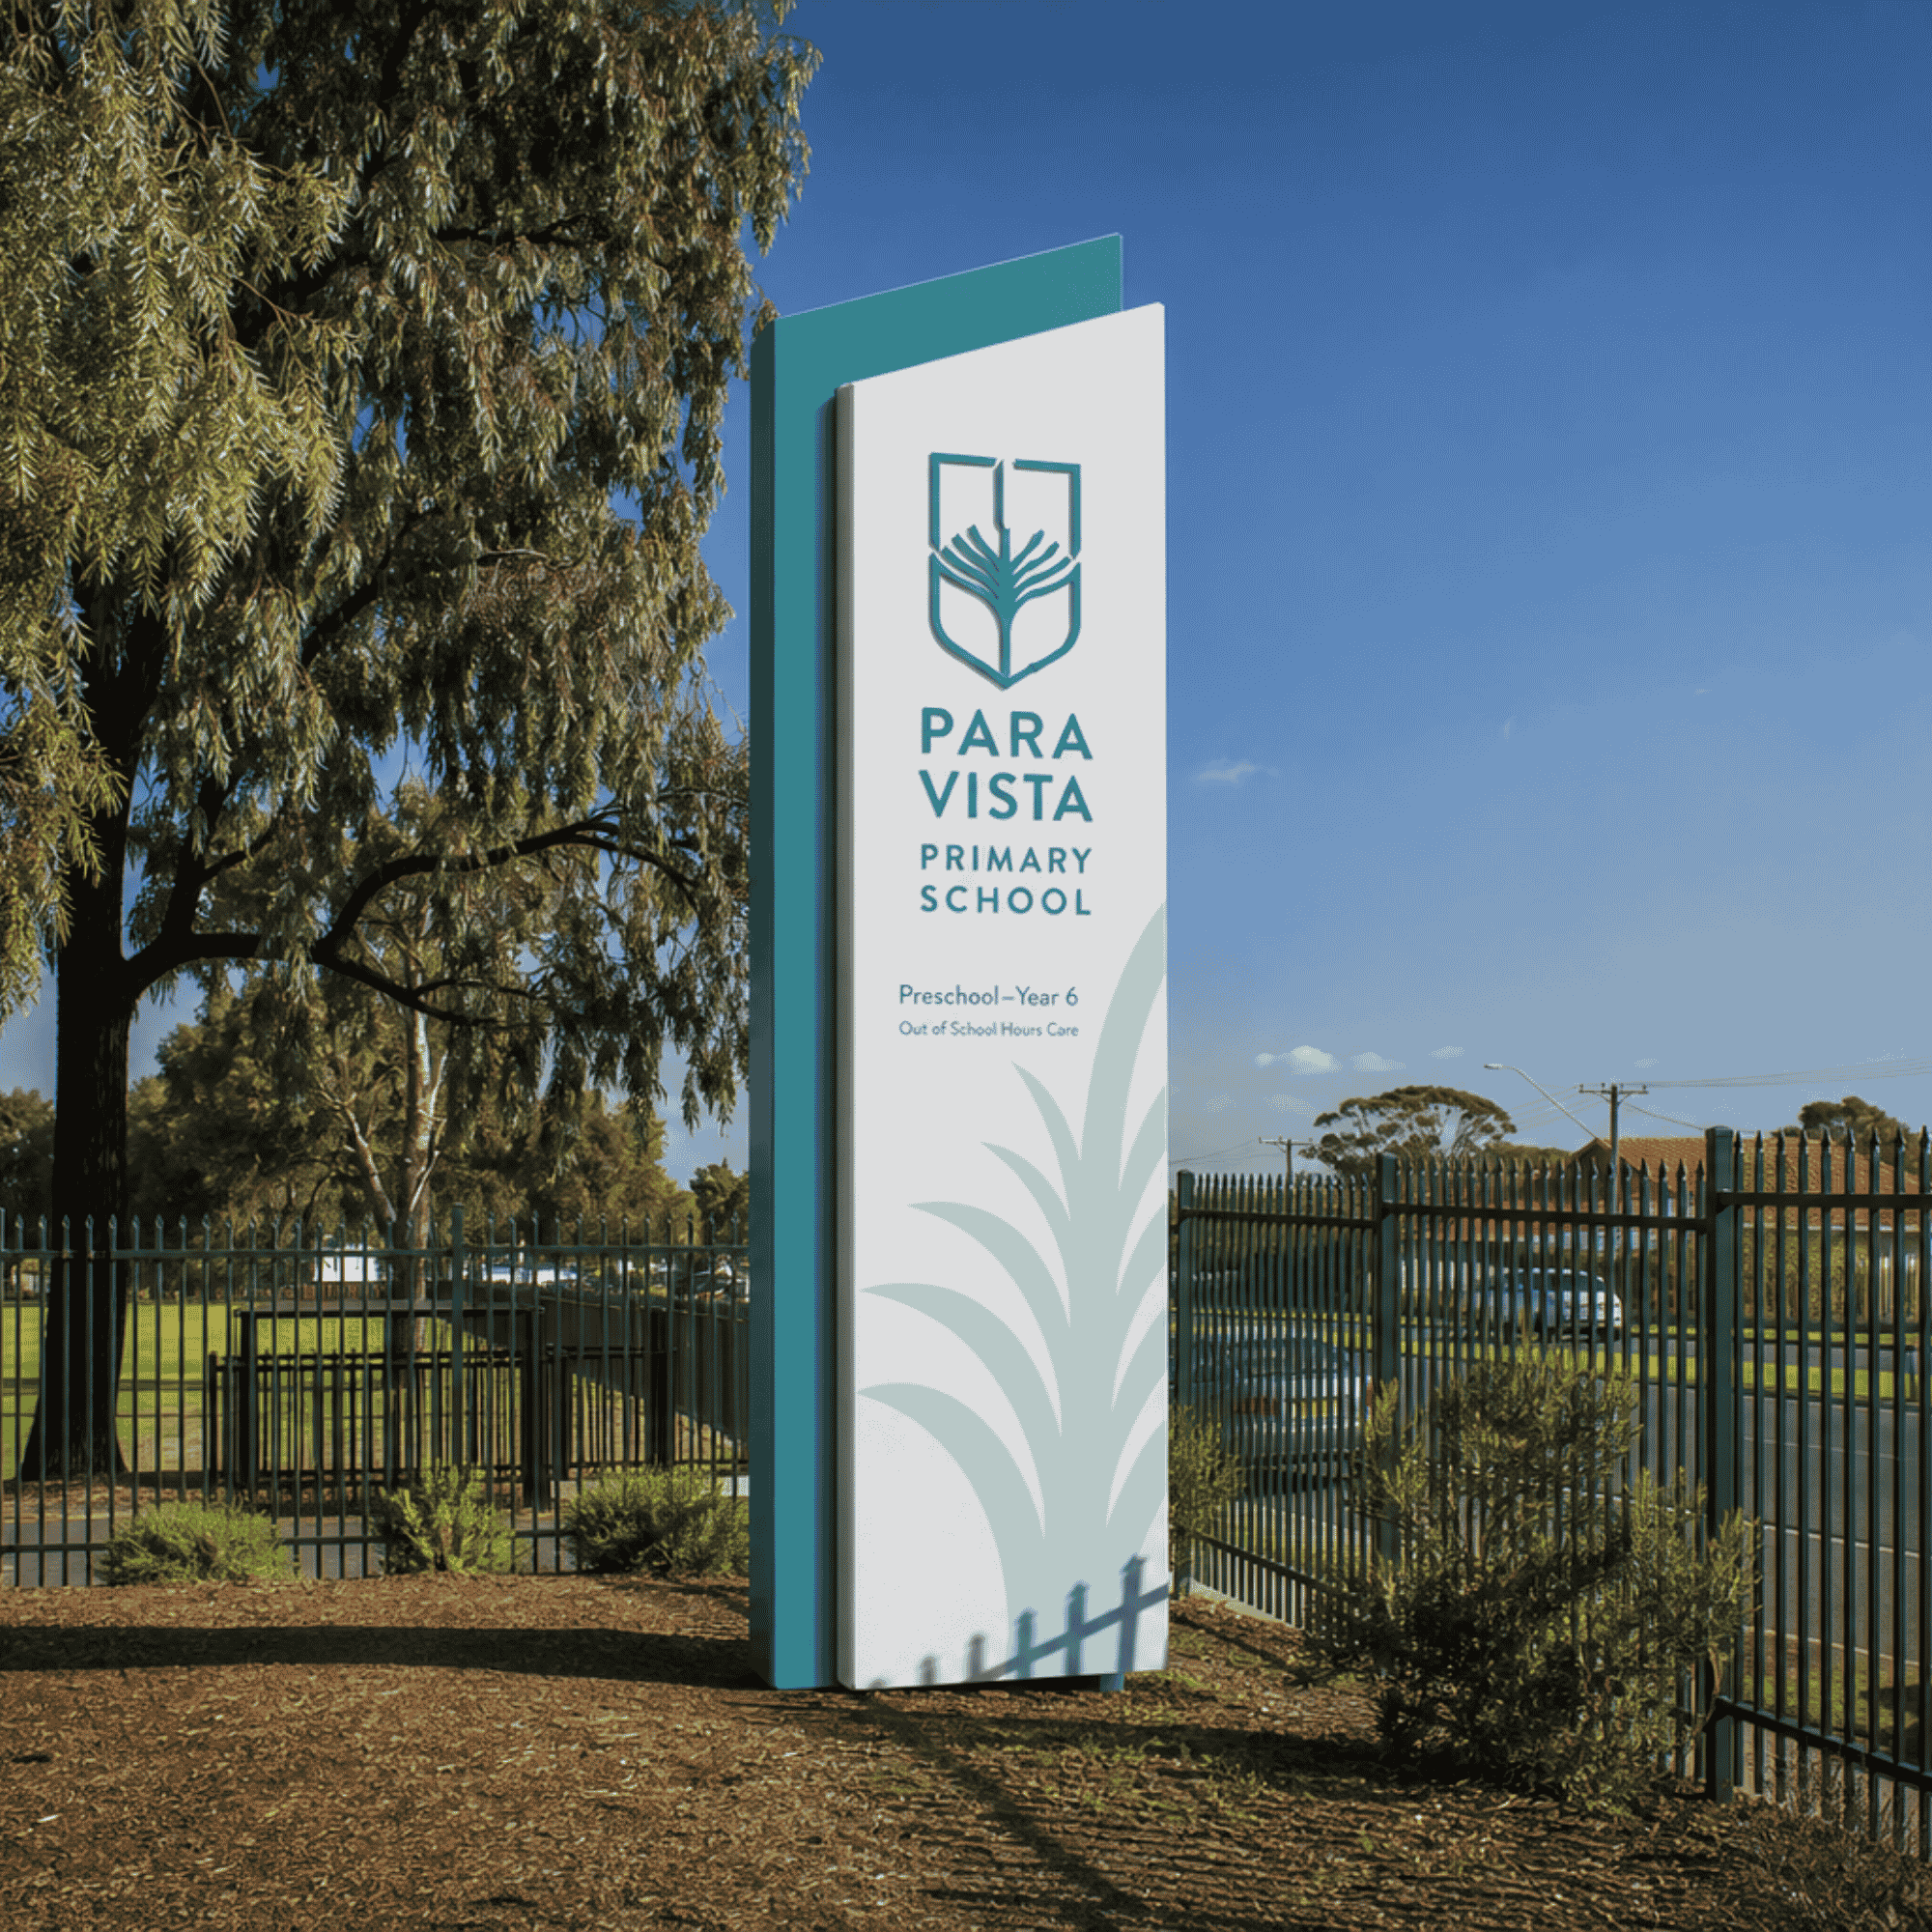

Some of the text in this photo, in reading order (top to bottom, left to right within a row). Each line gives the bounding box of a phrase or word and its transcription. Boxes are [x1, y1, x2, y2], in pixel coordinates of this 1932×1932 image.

[922, 707, 1093, 760] PARA
[919, 770, 1093, 822] VISTA
[922, 843, 1092, 873] PRIMARY
[921, 885, 1092, 916] SCHOOL
[1065, 986, 1078, 1006] 6
[899, 1021, 1079, 1037] Out of School Hours Care
